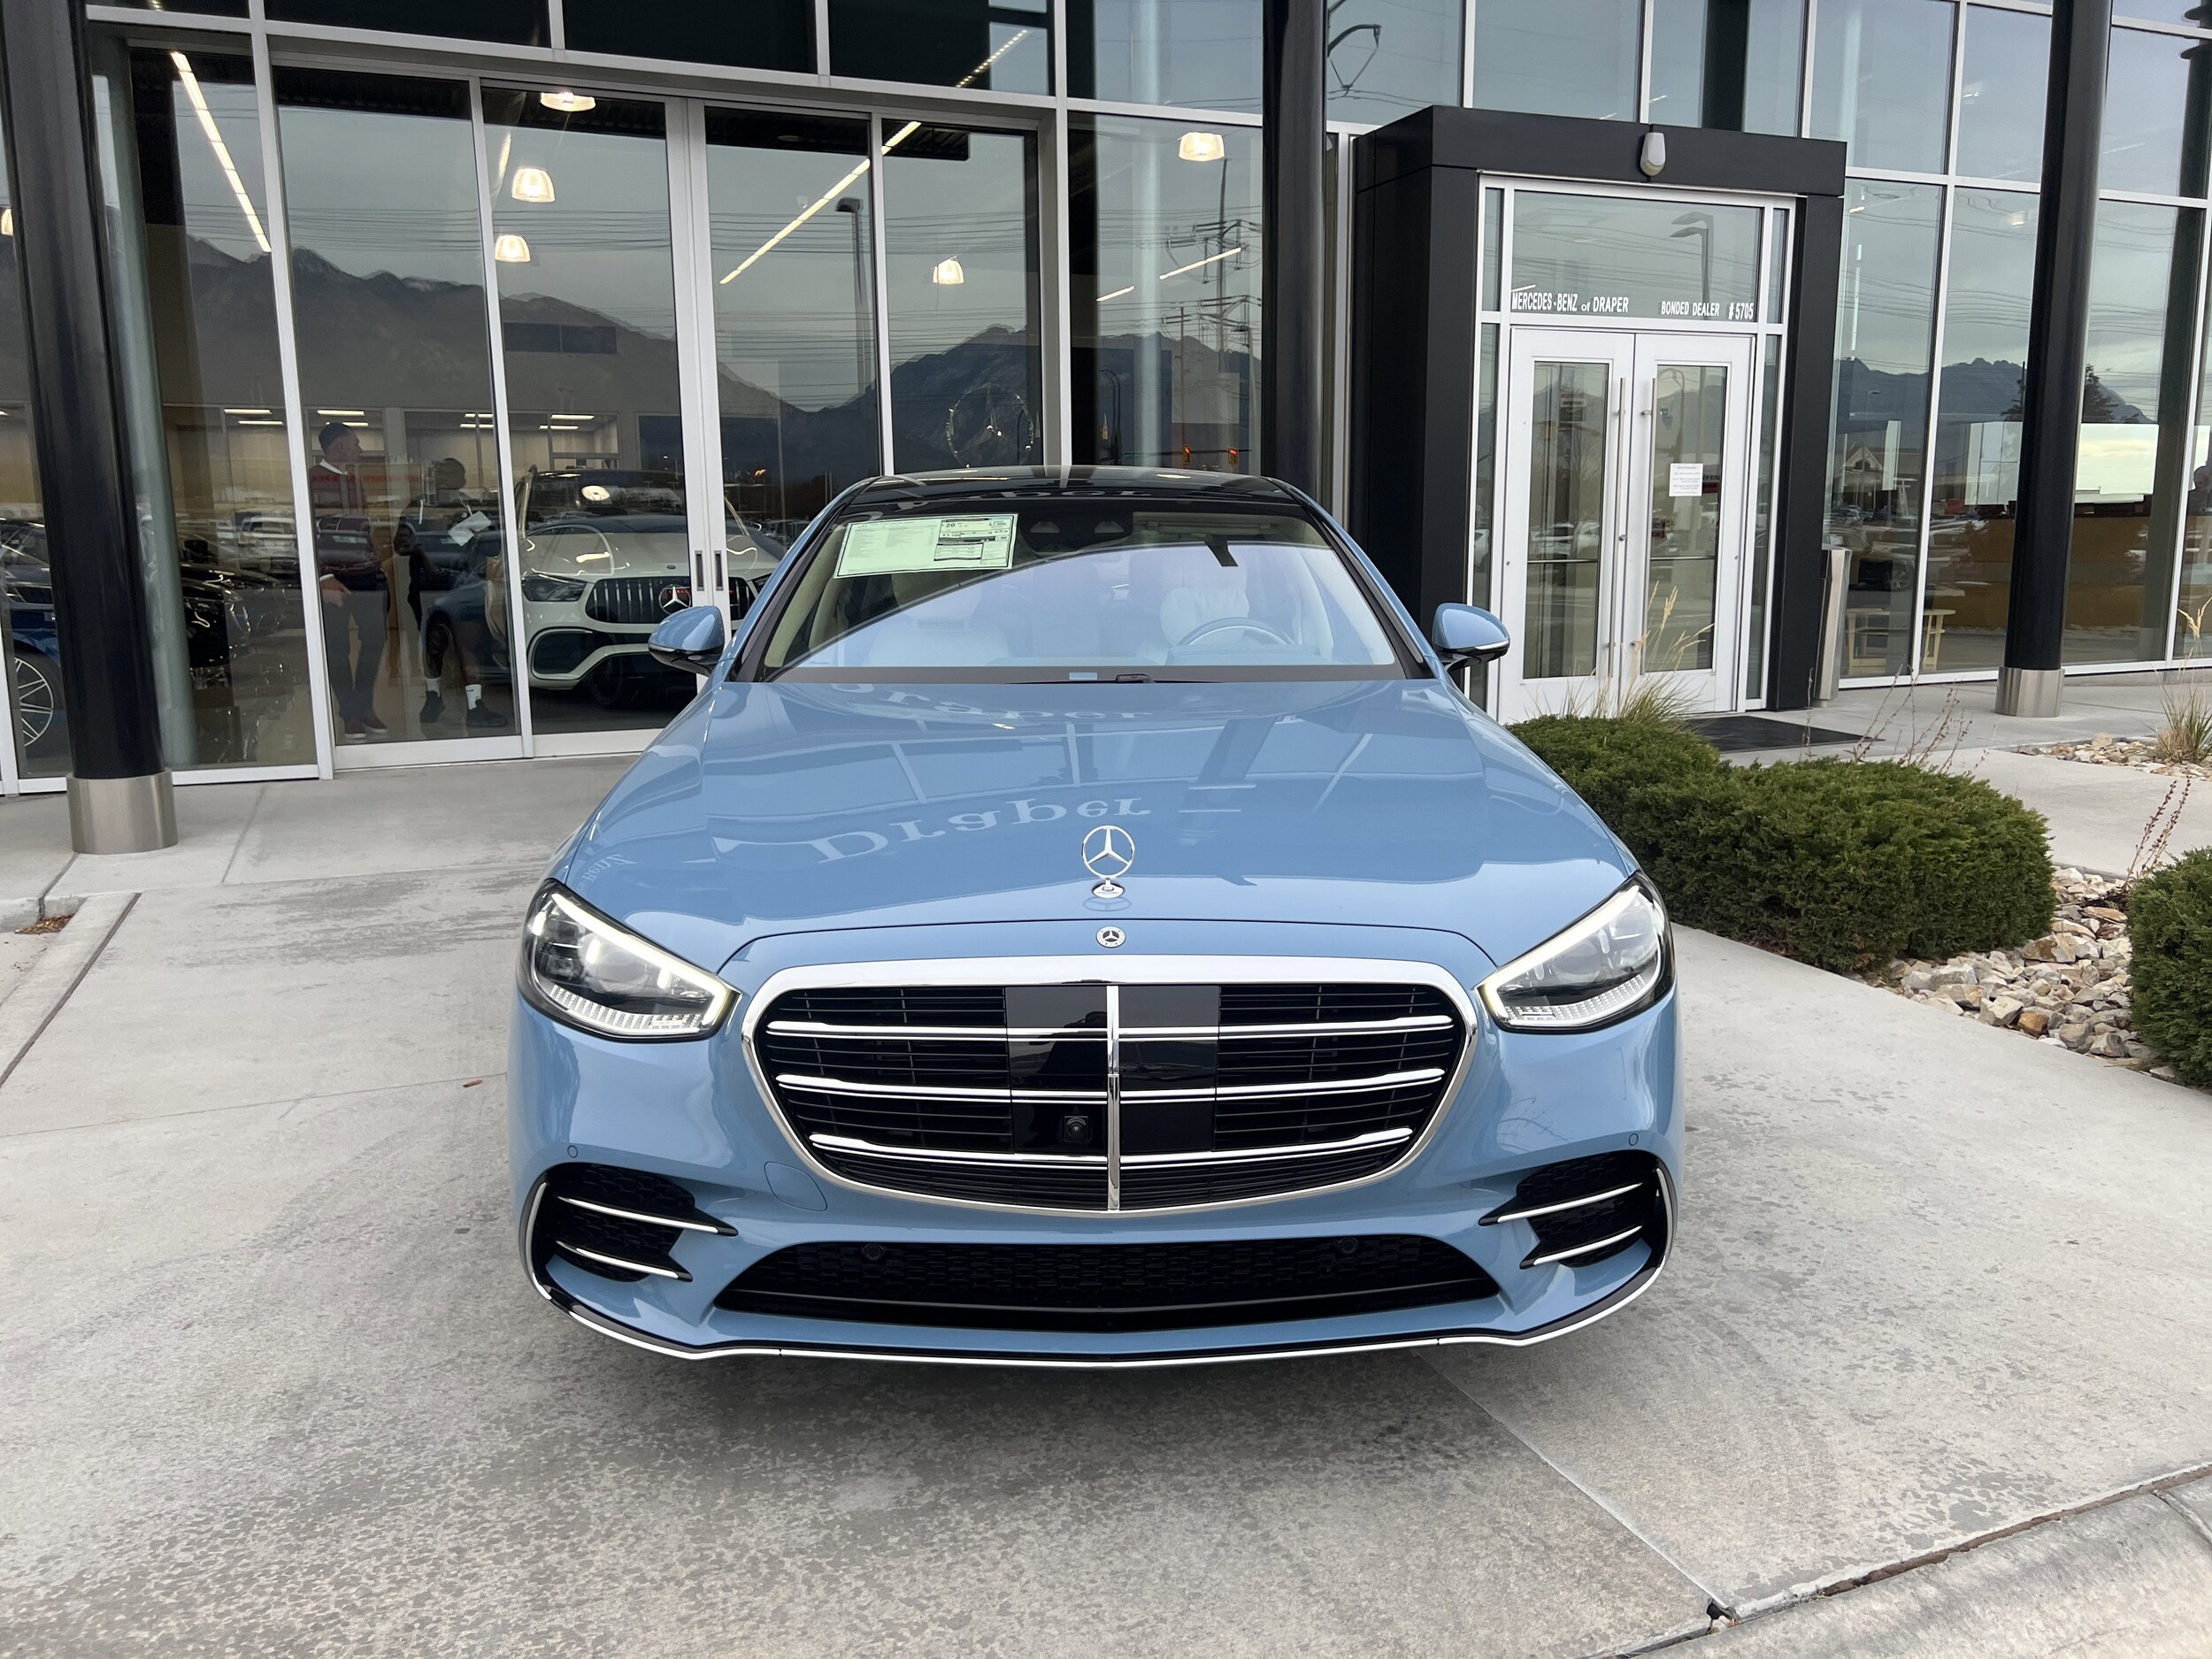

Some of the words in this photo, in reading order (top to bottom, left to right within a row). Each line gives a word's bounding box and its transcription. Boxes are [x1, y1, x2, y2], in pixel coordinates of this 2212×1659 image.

[1511, 292, 1578, 312] MERCEDES-BENZ
[1580, 302, 1591, 311] of
[1593, 296, 1629, 313] DRAPER
[1661, 301, 1690, 316] BONDED
[1692, 302, 1720, 317] DEALER
